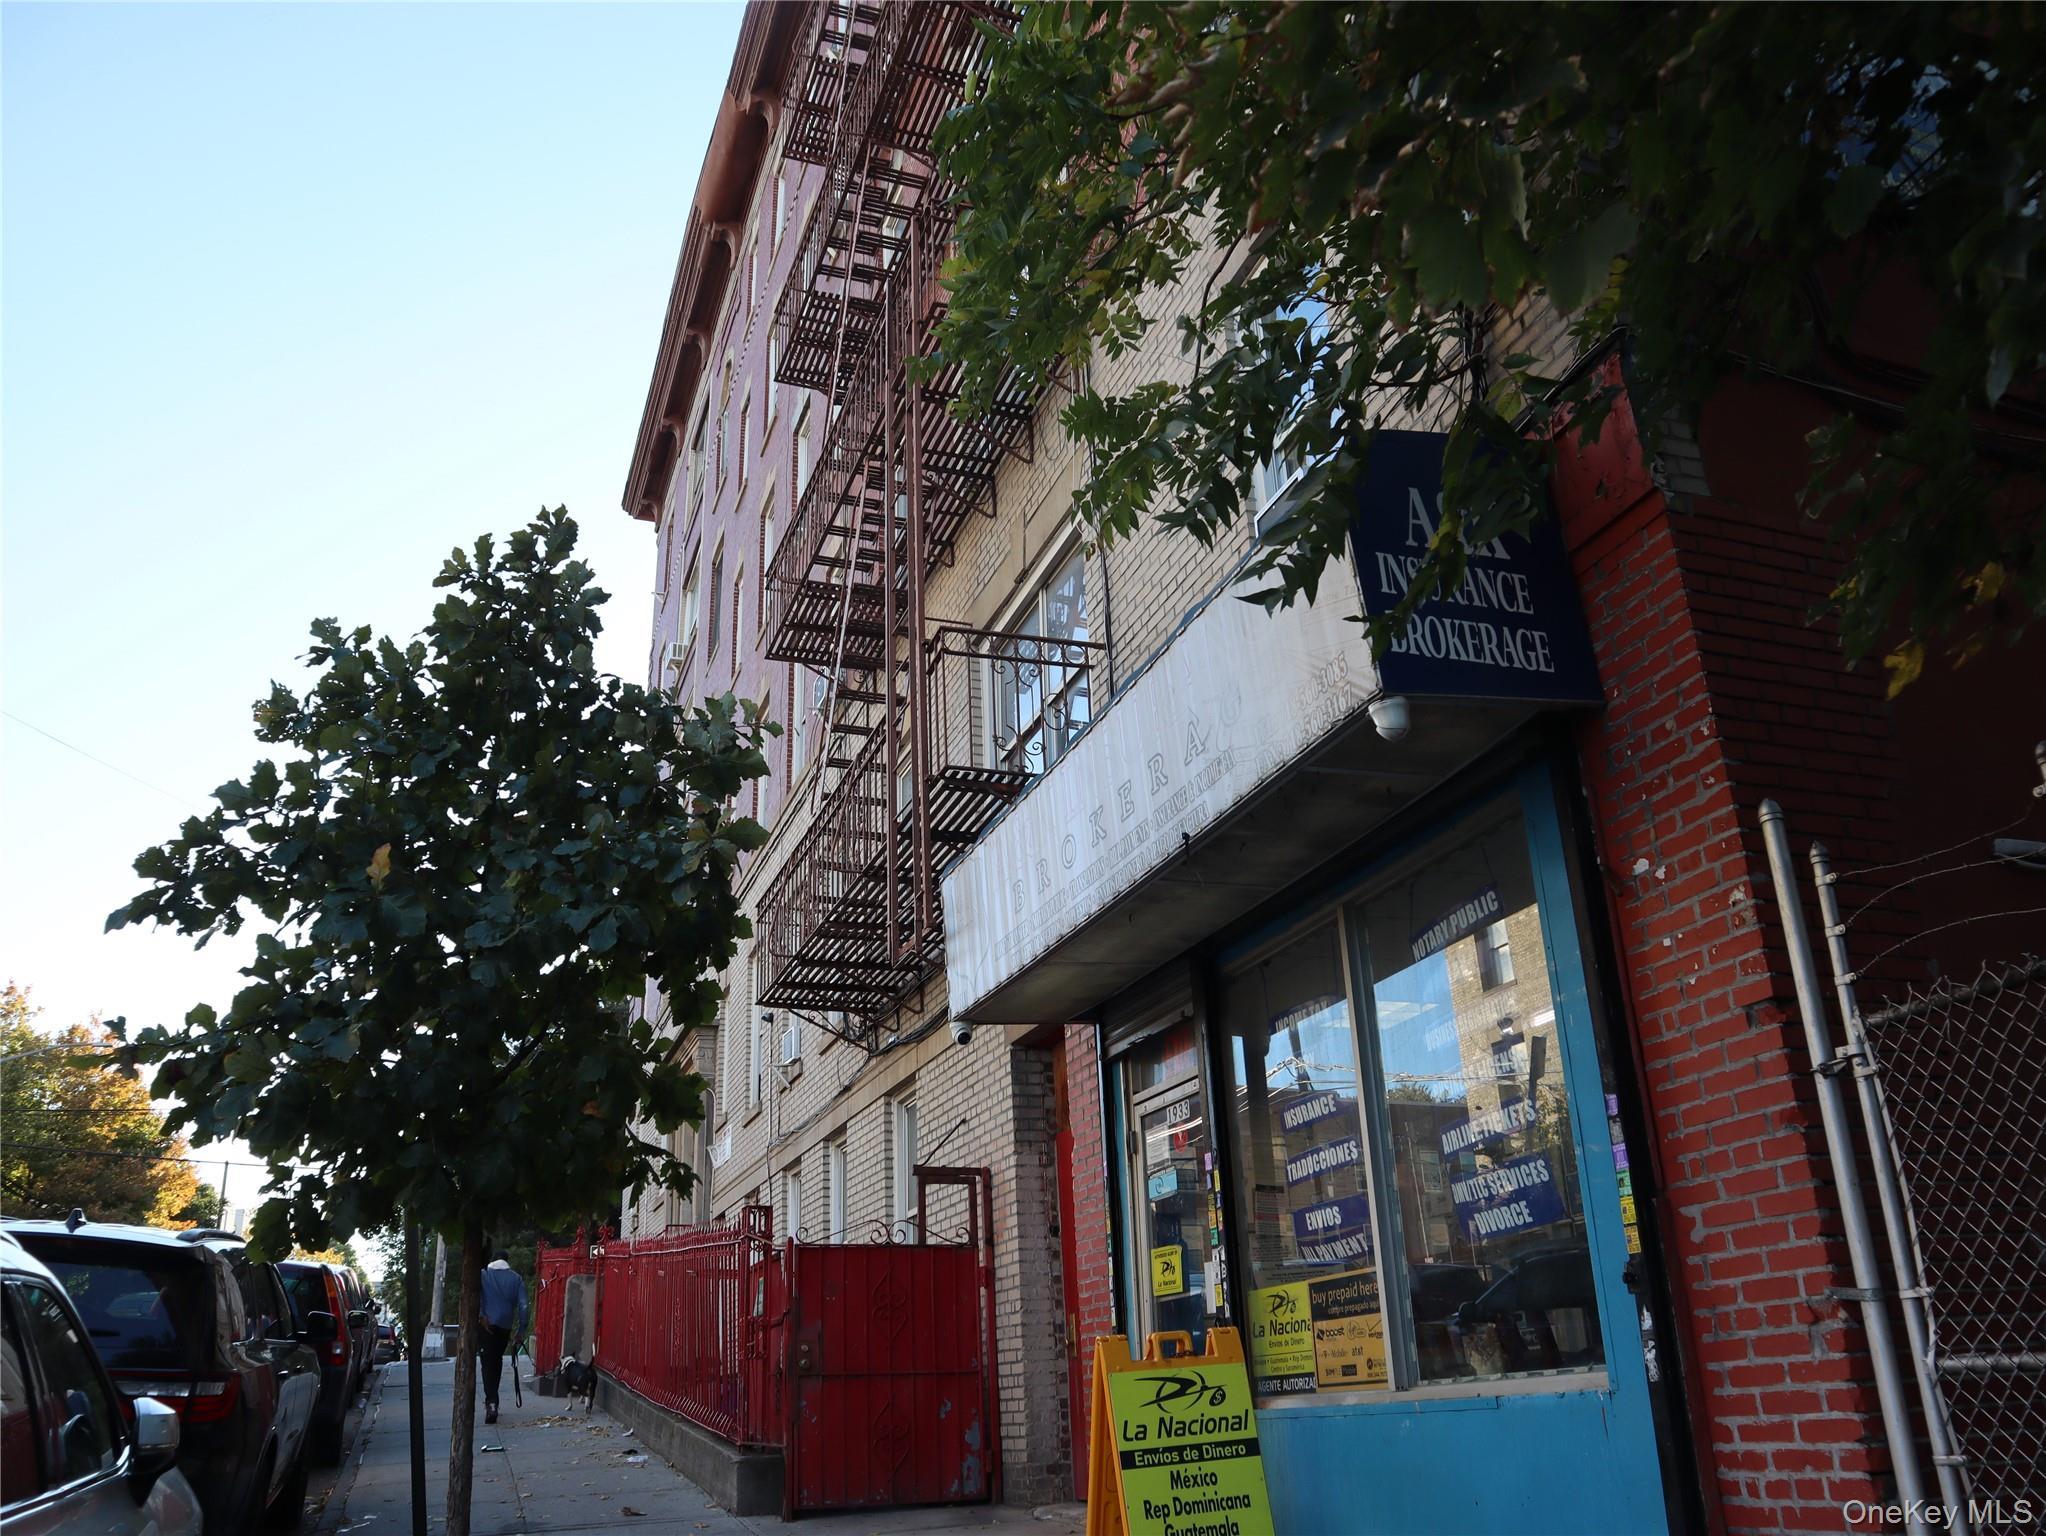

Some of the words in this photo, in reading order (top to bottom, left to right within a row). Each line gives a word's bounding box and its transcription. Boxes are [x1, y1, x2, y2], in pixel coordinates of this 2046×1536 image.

[1375, 551, 1534, 615] INANCE
[1412, 920, 1449, 962] NOTARY
[1449, 891, 1499, 935] PUBLIC
[1168, 1102, 1190, 1124] 1933
[1284, 1094, 1337, 1129] INSURANCE
[1441, 1120, 1483, 1154] AIRLINE
[1482, 1100, 1536, 1136] TICKETS
[1287, 1140, 1359, 1182] TRADUCCIONES
[1487, 1159, 1550, 1195] SERVICES
[1305, 1206, 1342, 1231] ENVIOS
[1474, 1200, 1533, 1235] DIVORCE
[1315, 1233, 1368, 1262] PAYMENT
[1311, 1290, 1326, 1307] buy
[1328, 1281, 1358, 1304] prepaid
[1359, 1280, 1379, 1296] here
[1253, 1321, 1265, 1338] La
[1269, 1317, 1312, 1336] Naciona
[1326, 1327, 1345, 1338] boost
[1258, 1380, 1281, 1393] AGENTE
[1122, 1420, 1148, 1442] La
[1157, 1409, 1249, 1439] Nacional
[1134, 1447, 1180, 1466] Envíos
[1183, 1447, 1200, 1461] de
[1203, 1443, 1246, 1459] Dinero
[1170, 1466, 1218, 1491] México
[1143, 1499, 1171, 1524] Rep
[1174, 1491, 1251, 1517] Dominicana
[1164, 1516, 1240, 1536] Guatemala
